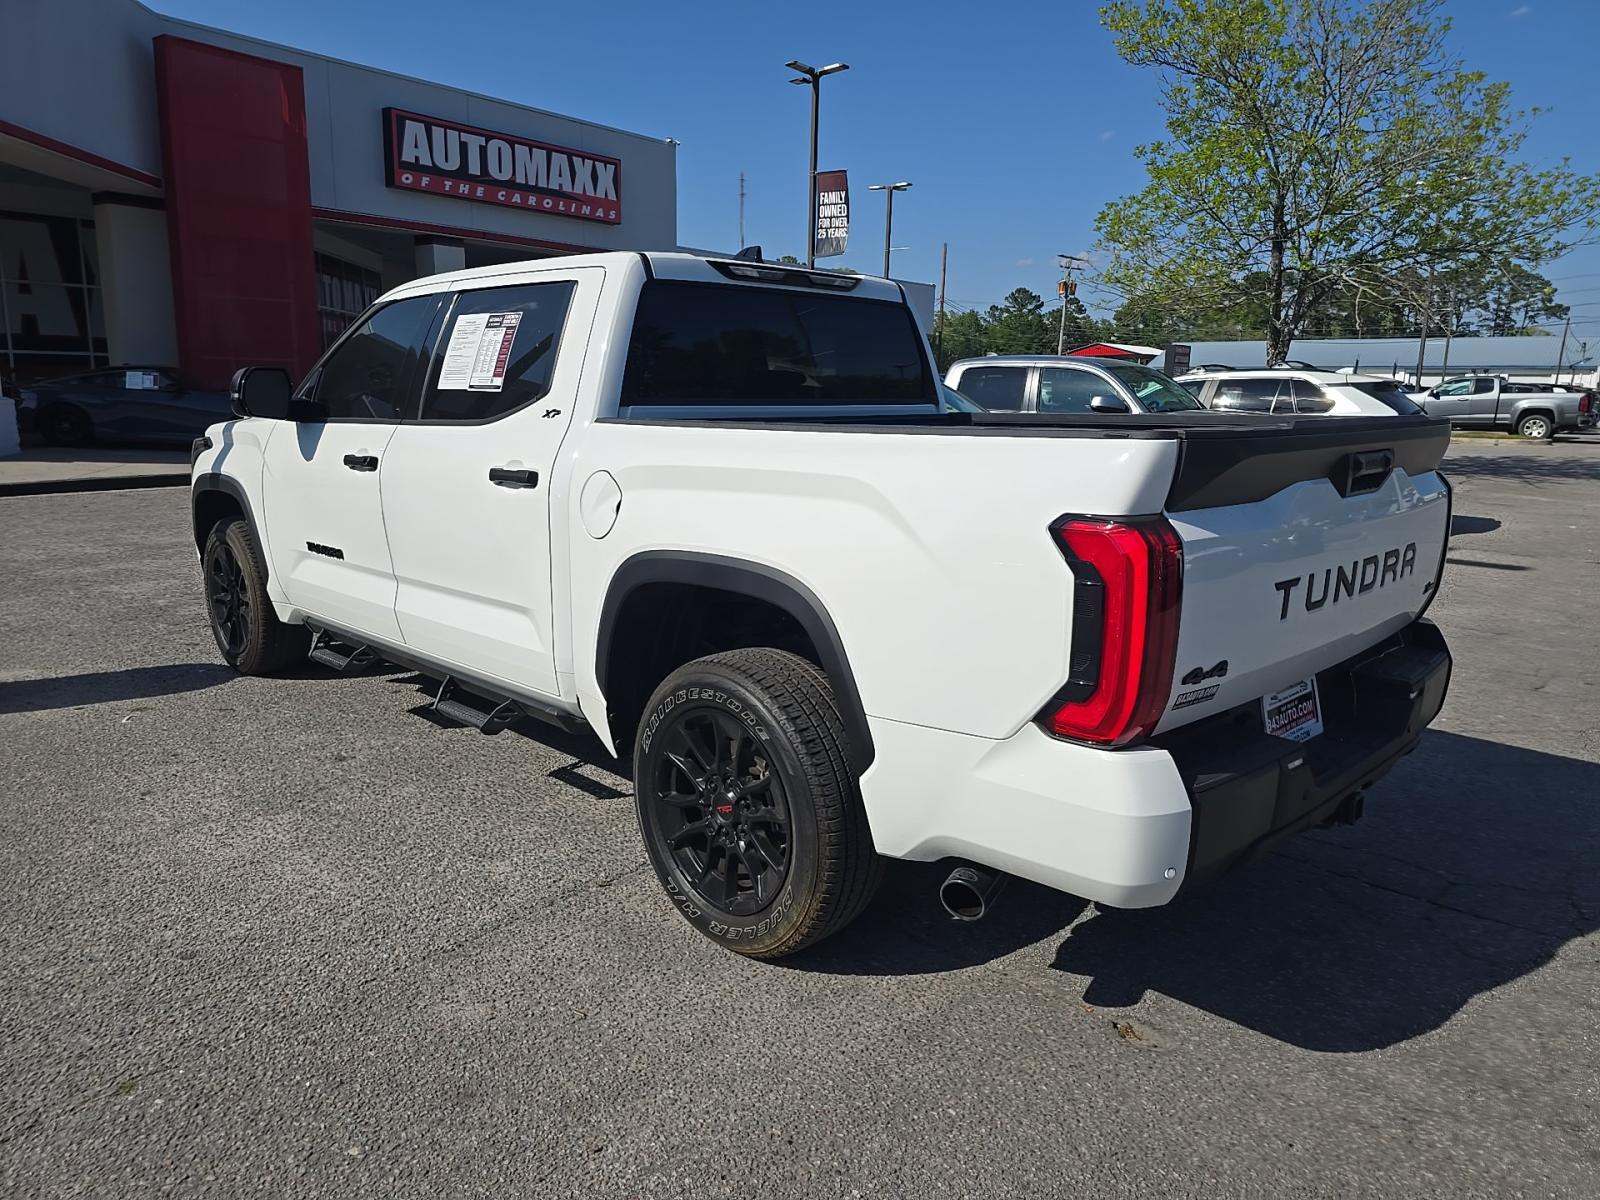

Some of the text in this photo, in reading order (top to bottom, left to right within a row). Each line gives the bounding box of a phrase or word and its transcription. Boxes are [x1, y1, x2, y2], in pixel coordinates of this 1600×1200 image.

[401, 119, 618, 201] AUTOMAXX
[401, 173, 617, 220] OF THE CAROLINAS
[819, 191, 846, 205] FAMILY
[819, 204, 847, 218] OWNED
[817, 227, 848, 239] 25 YEARS
[818, 217, 848, 228] FOR OVER
[1274, 542, 1417, 622] TUNDRA
[641, 687, 769, 754] BRIDGESTONE
[1266, 699, 1315, 732] 843AUTO.COM
[708, 885, 793, 940] DUELER
